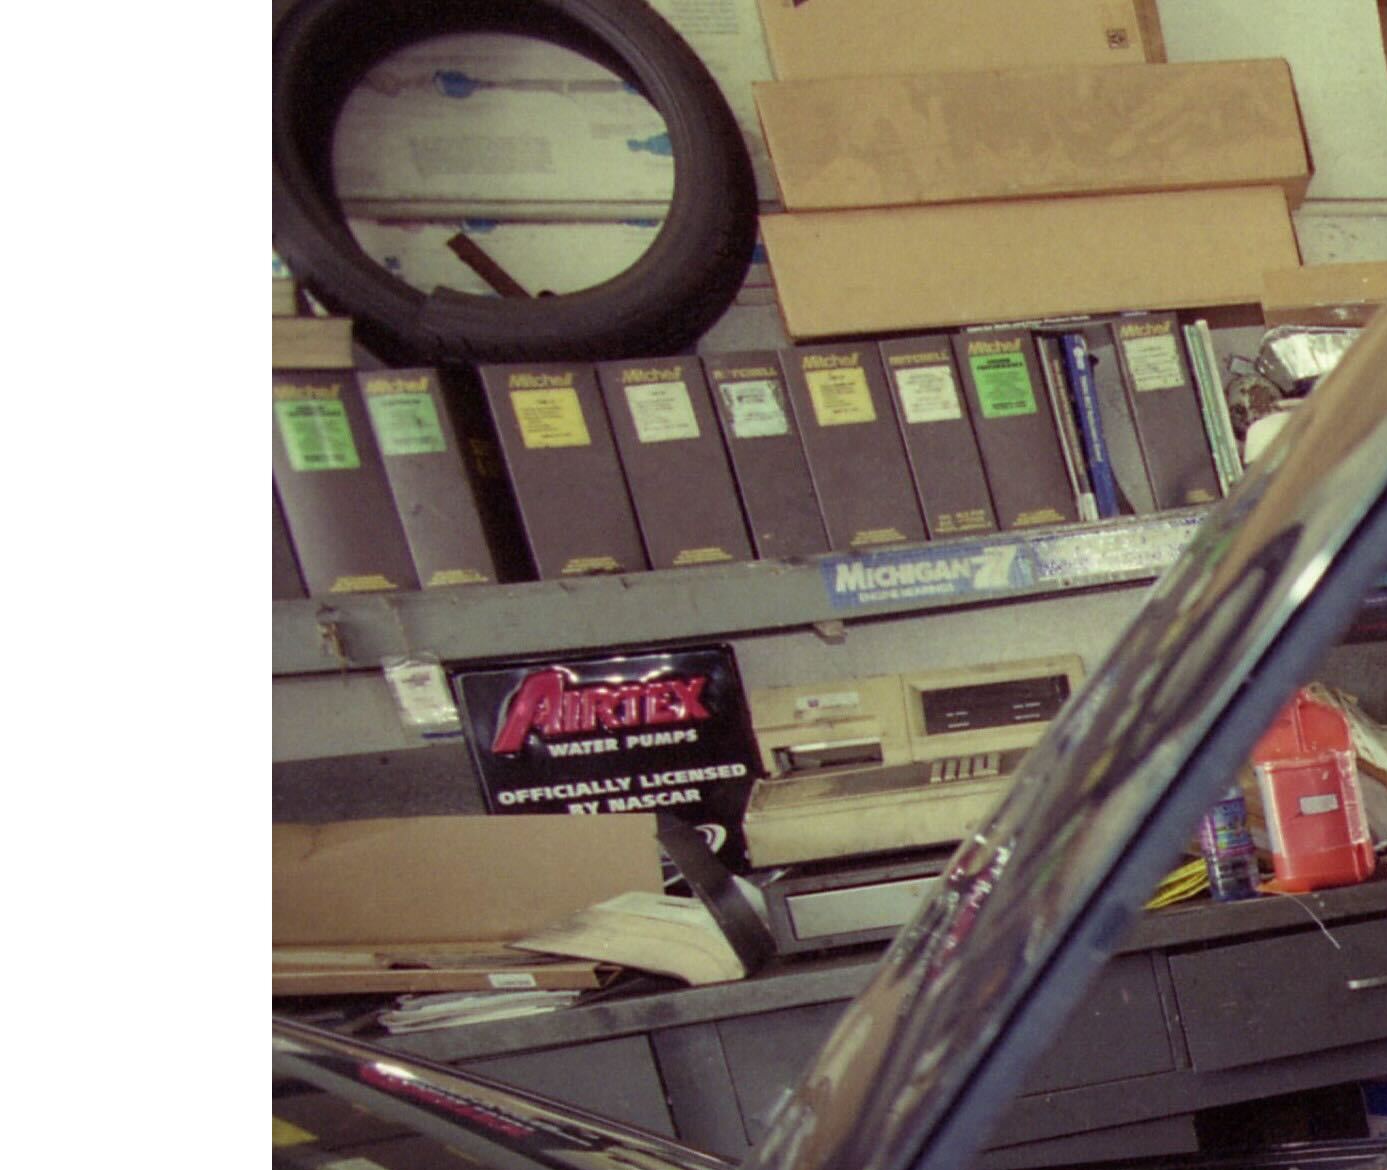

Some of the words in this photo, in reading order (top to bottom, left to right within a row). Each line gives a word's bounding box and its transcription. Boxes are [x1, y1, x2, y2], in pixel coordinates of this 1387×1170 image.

[835, 557, 971, 593] MICHIGAN
[491, 667, 711, 754] AIRTEX
[549, 737, 619, 758] WATER
[626, 728, 699, 750] PUMPS
[496, 776, 632, 806] OFFICIALLY
[638, 763, 748, 788] LICENSED
[566, 803, 602, 815] BY
[607, 788, 702, 814] NASCAR
